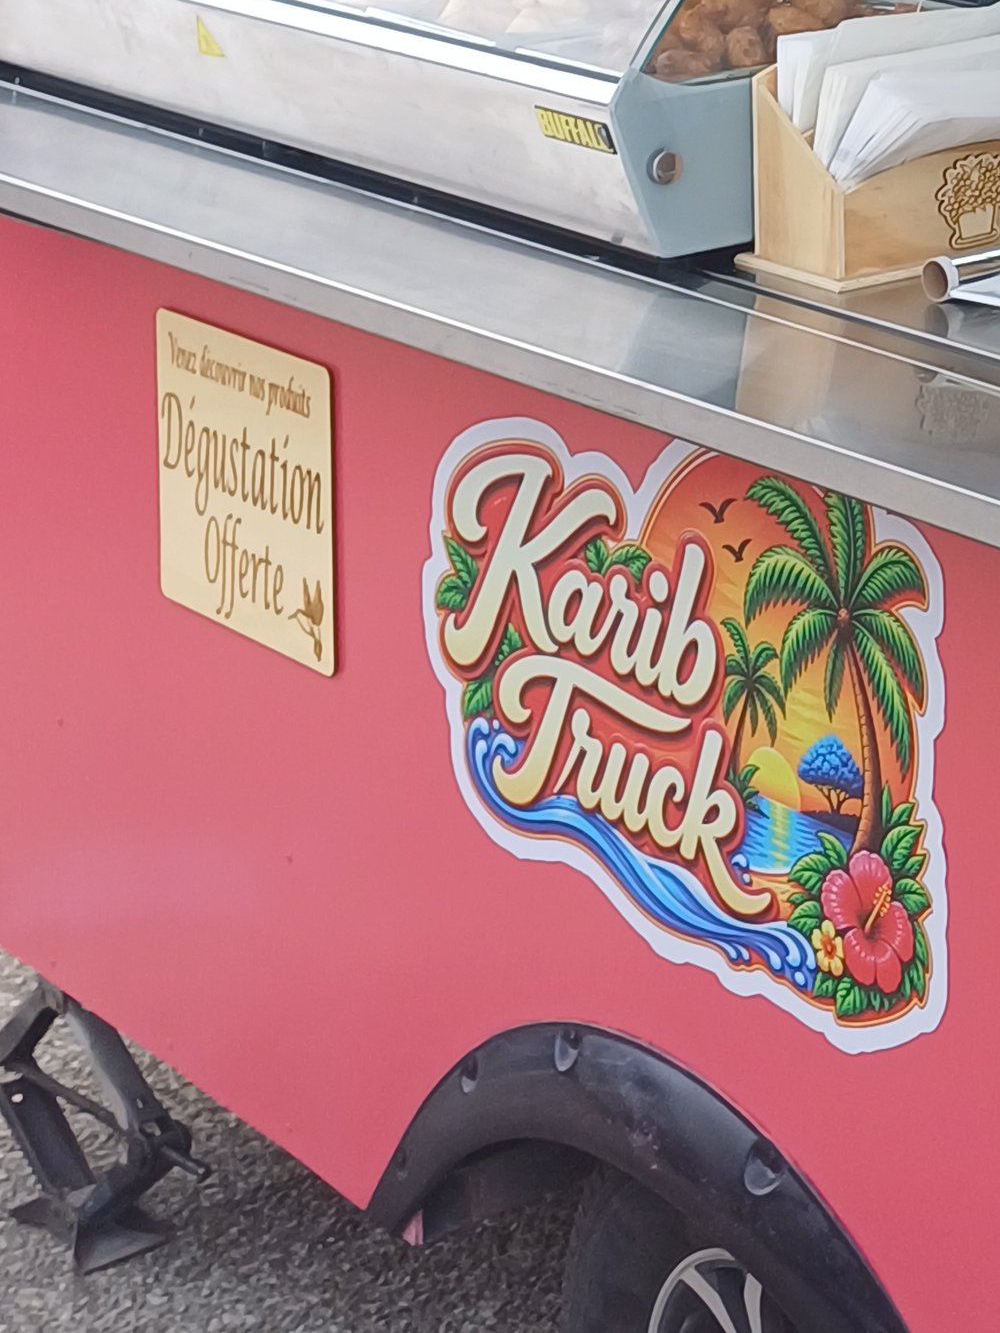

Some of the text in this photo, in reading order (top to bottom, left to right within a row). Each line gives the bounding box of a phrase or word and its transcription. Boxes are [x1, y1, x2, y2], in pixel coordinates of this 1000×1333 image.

[168, 331, 196, 374] Venez
[249, 373, 265, 402] nos
[265, 376, 312, 419] produits
[161, 391, 325, 535] Dégustation
[204, 513, 284, 619] Offerte
[444, 453, 718, 708] Karib
[493, 655, 773, 917] Truck
